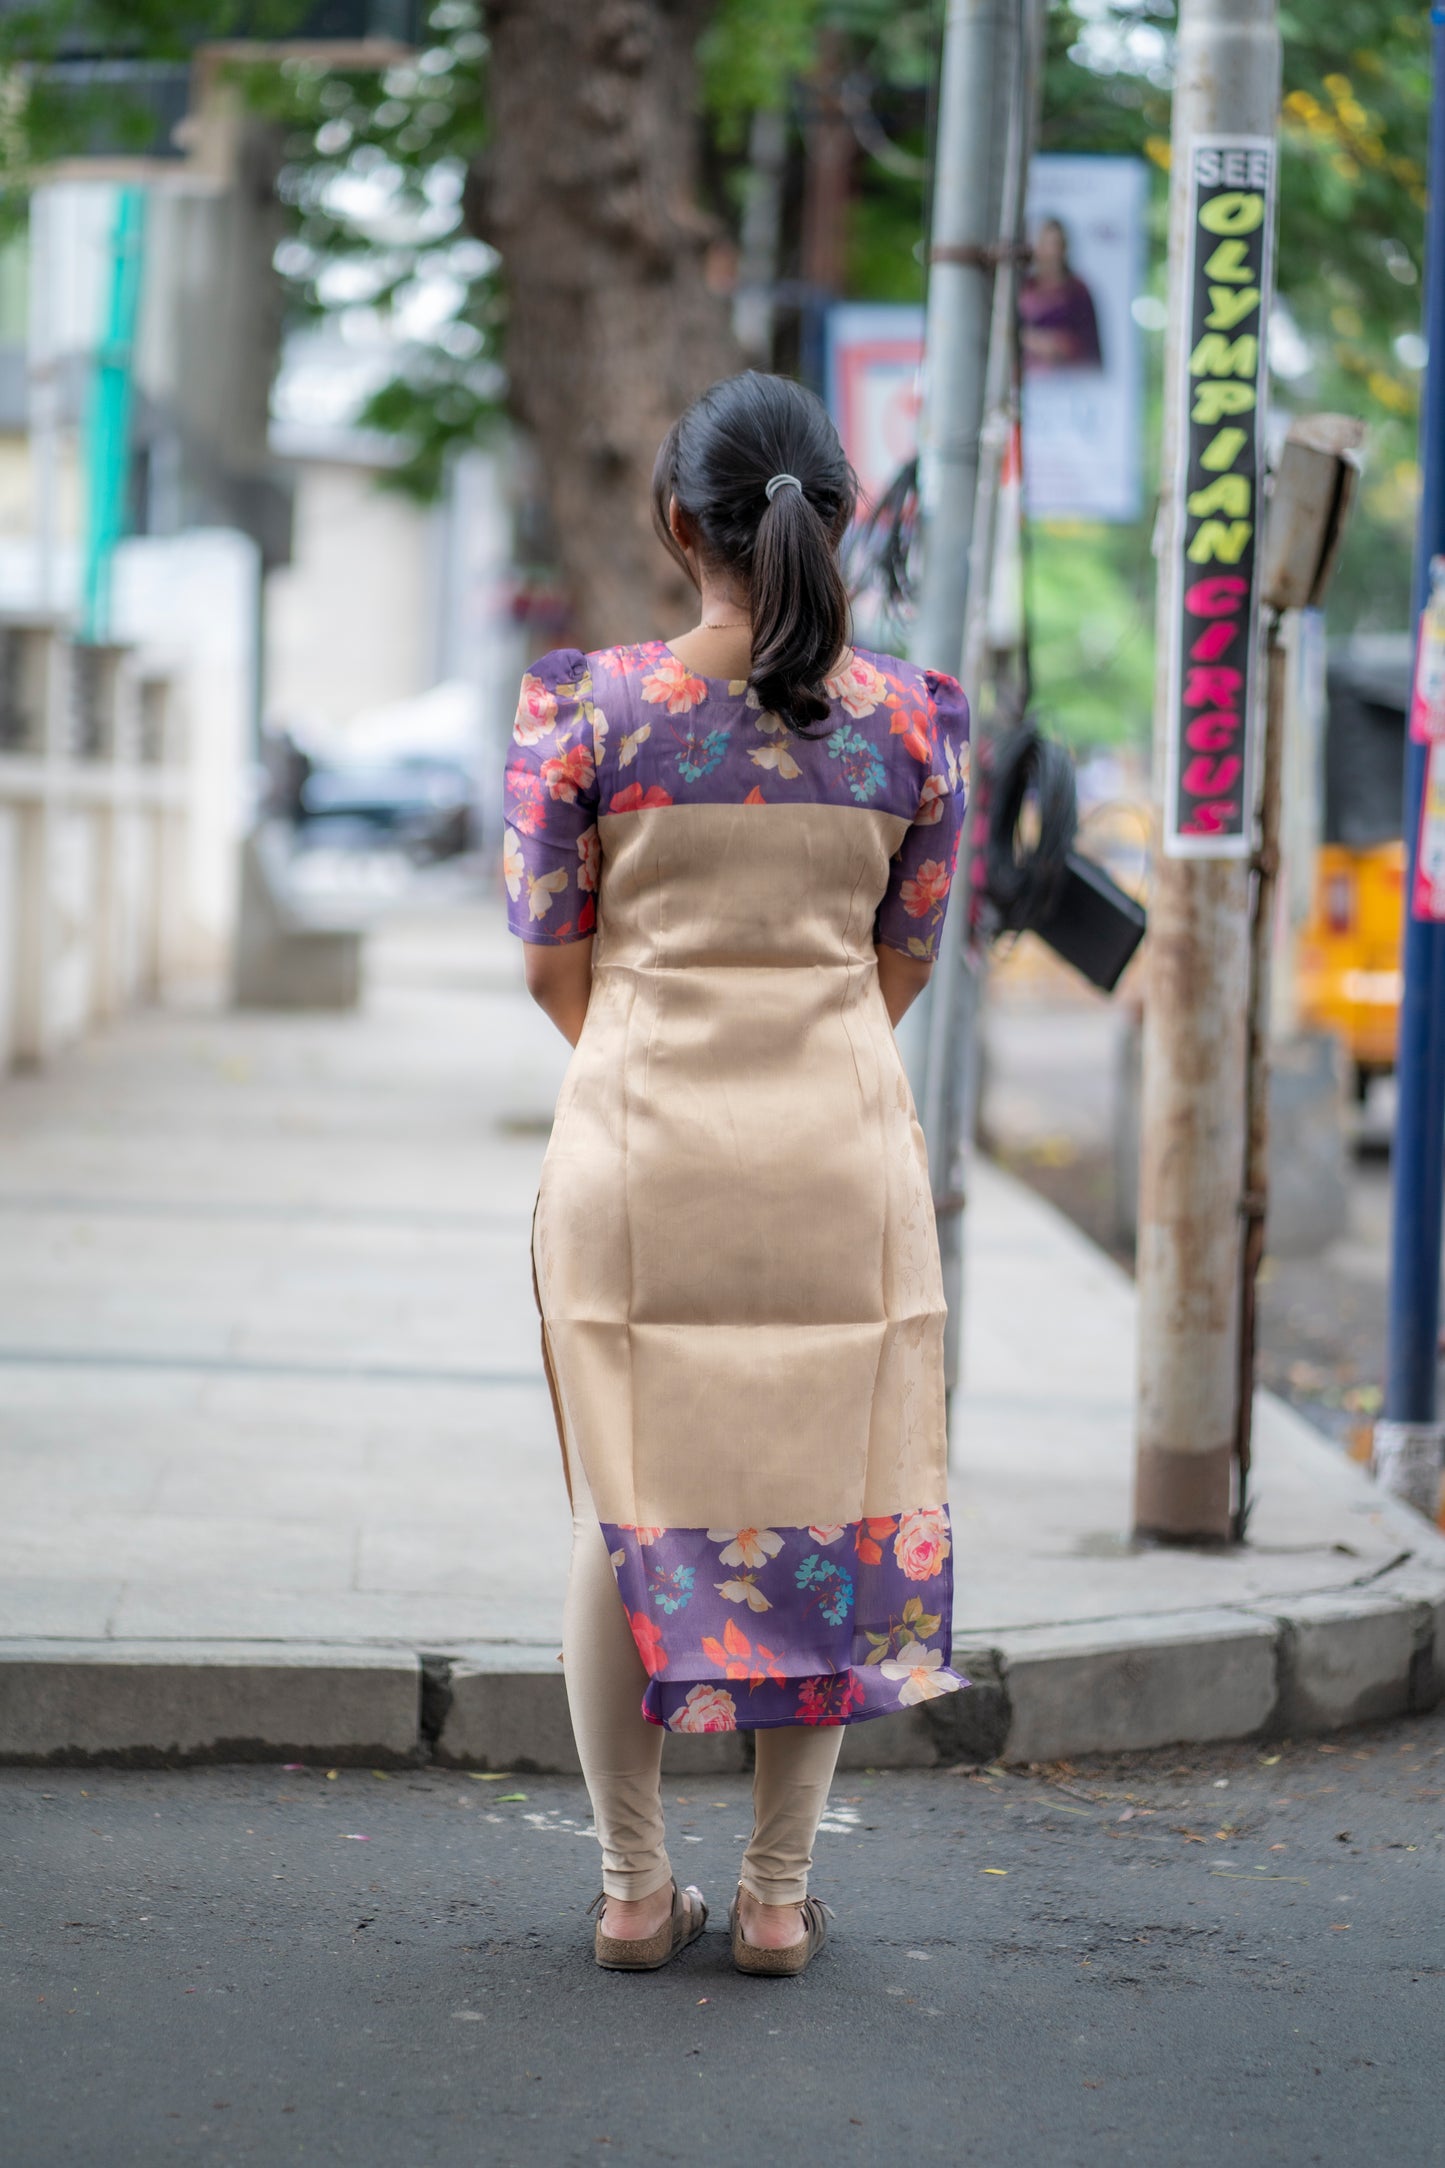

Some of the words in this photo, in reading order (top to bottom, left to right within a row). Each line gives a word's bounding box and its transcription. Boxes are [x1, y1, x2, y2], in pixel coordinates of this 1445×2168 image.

[1196, 151, 1269, 187] SEE
[1188, 191, 1264, 564] OLYMPIAN
[1179, 575, 1248, 835] CIRCUS
